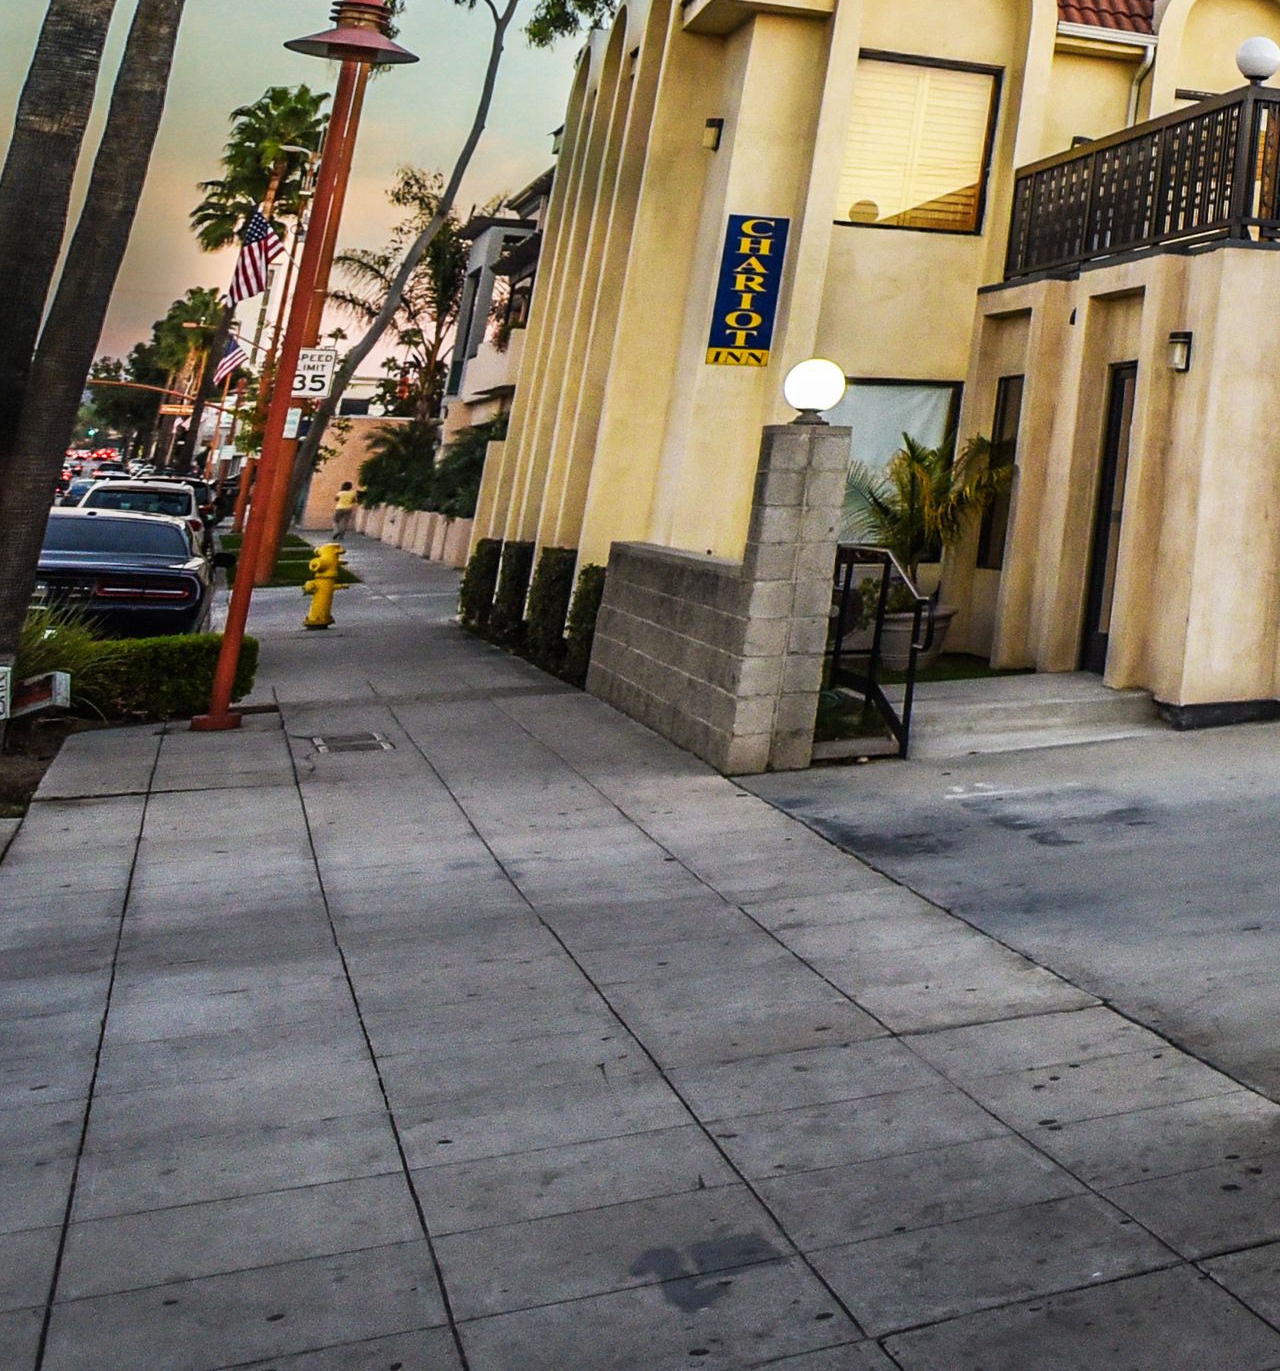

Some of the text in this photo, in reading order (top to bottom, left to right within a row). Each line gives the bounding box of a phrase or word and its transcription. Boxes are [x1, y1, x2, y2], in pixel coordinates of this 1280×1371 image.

[725, 219, 775, 347] CHARIOT
[300, 354, 333, 362] PEED
[713, 350, 764, 364] INN
[298, 364, 326, 372] IMIT
[292, 373, 326, 392] 35
